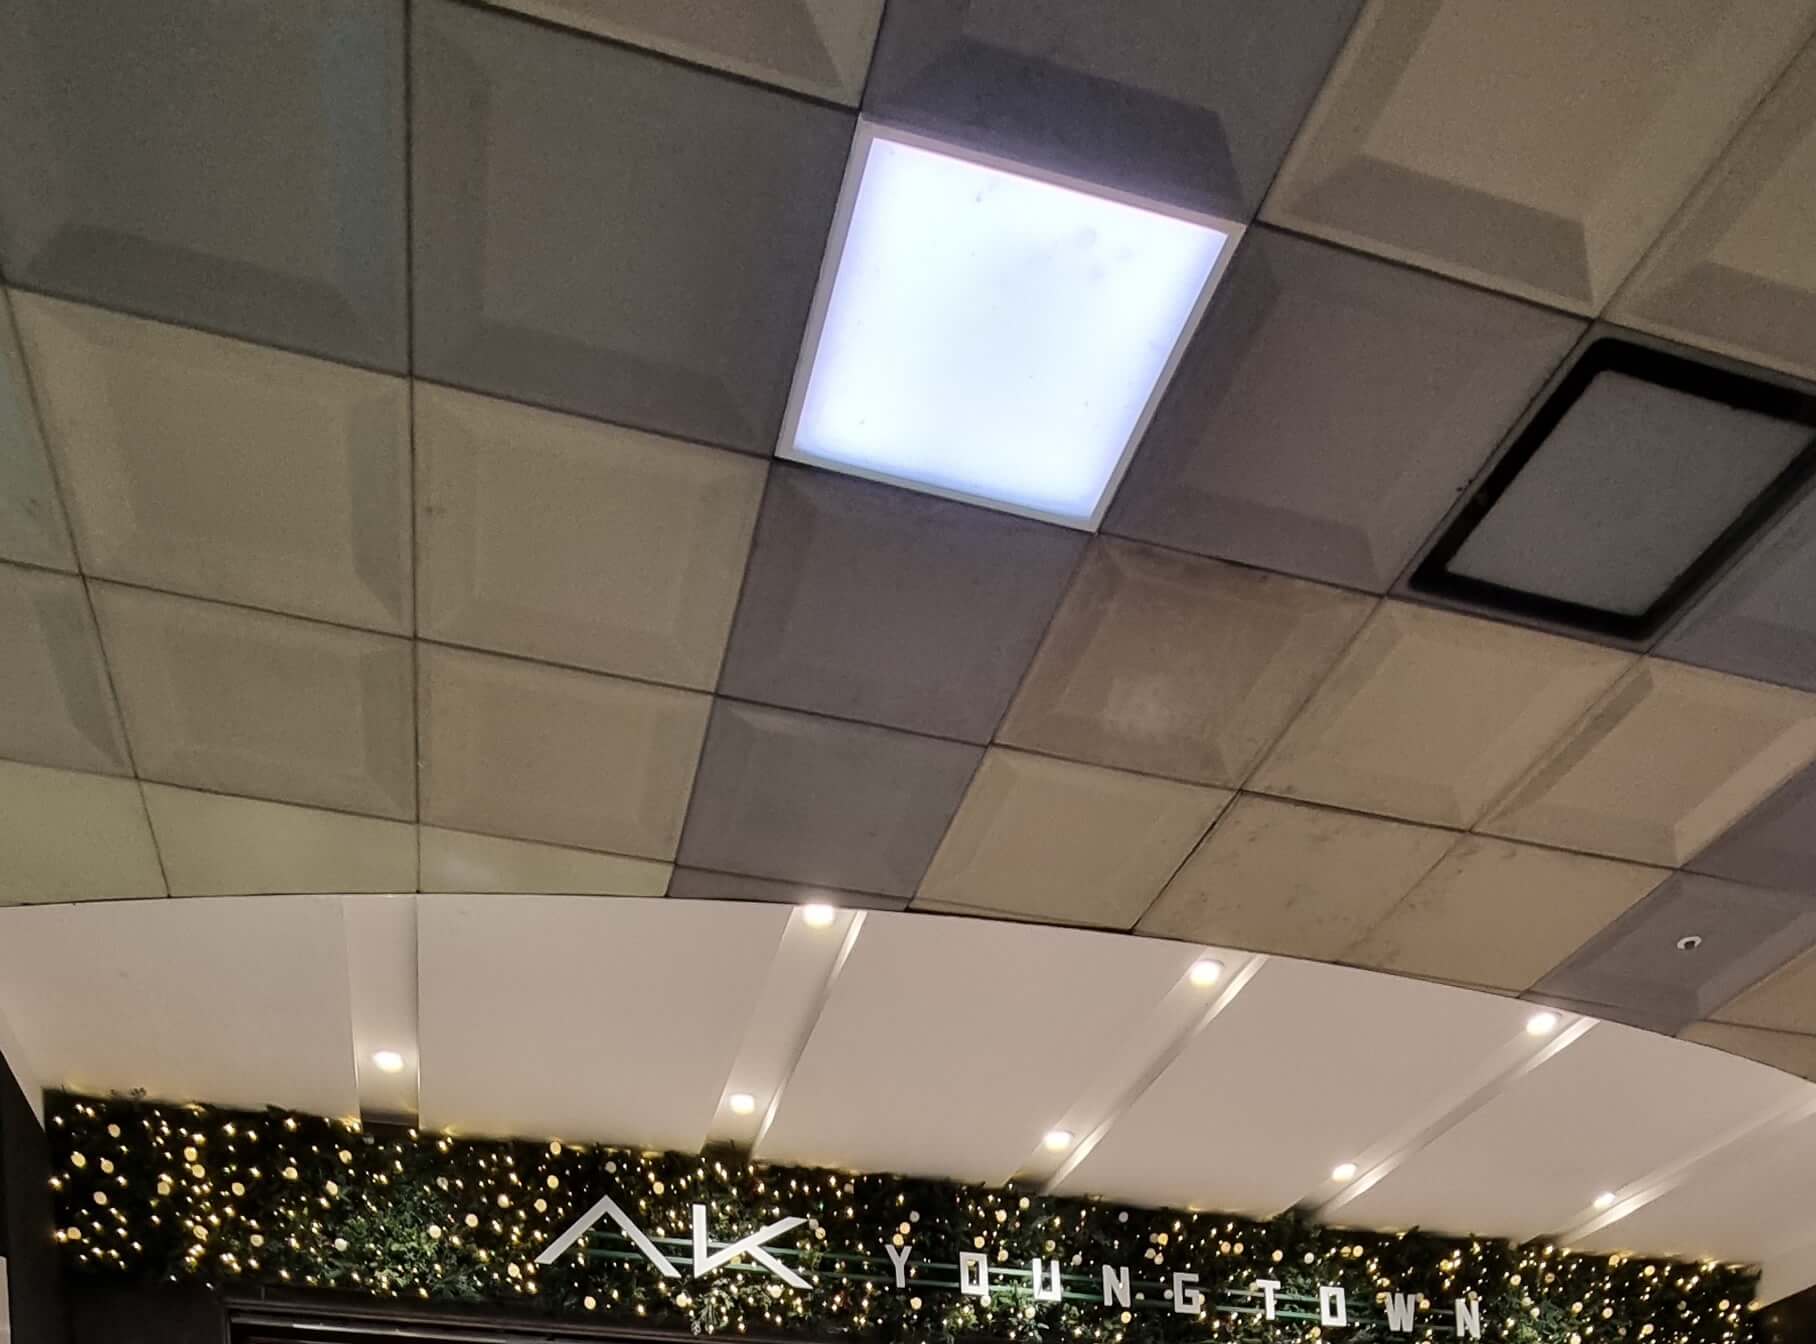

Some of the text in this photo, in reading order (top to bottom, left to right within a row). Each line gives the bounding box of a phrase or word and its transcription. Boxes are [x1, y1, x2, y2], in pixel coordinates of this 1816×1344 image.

[534, 1194, 1482, 1338] AK YOUNG TOWN
